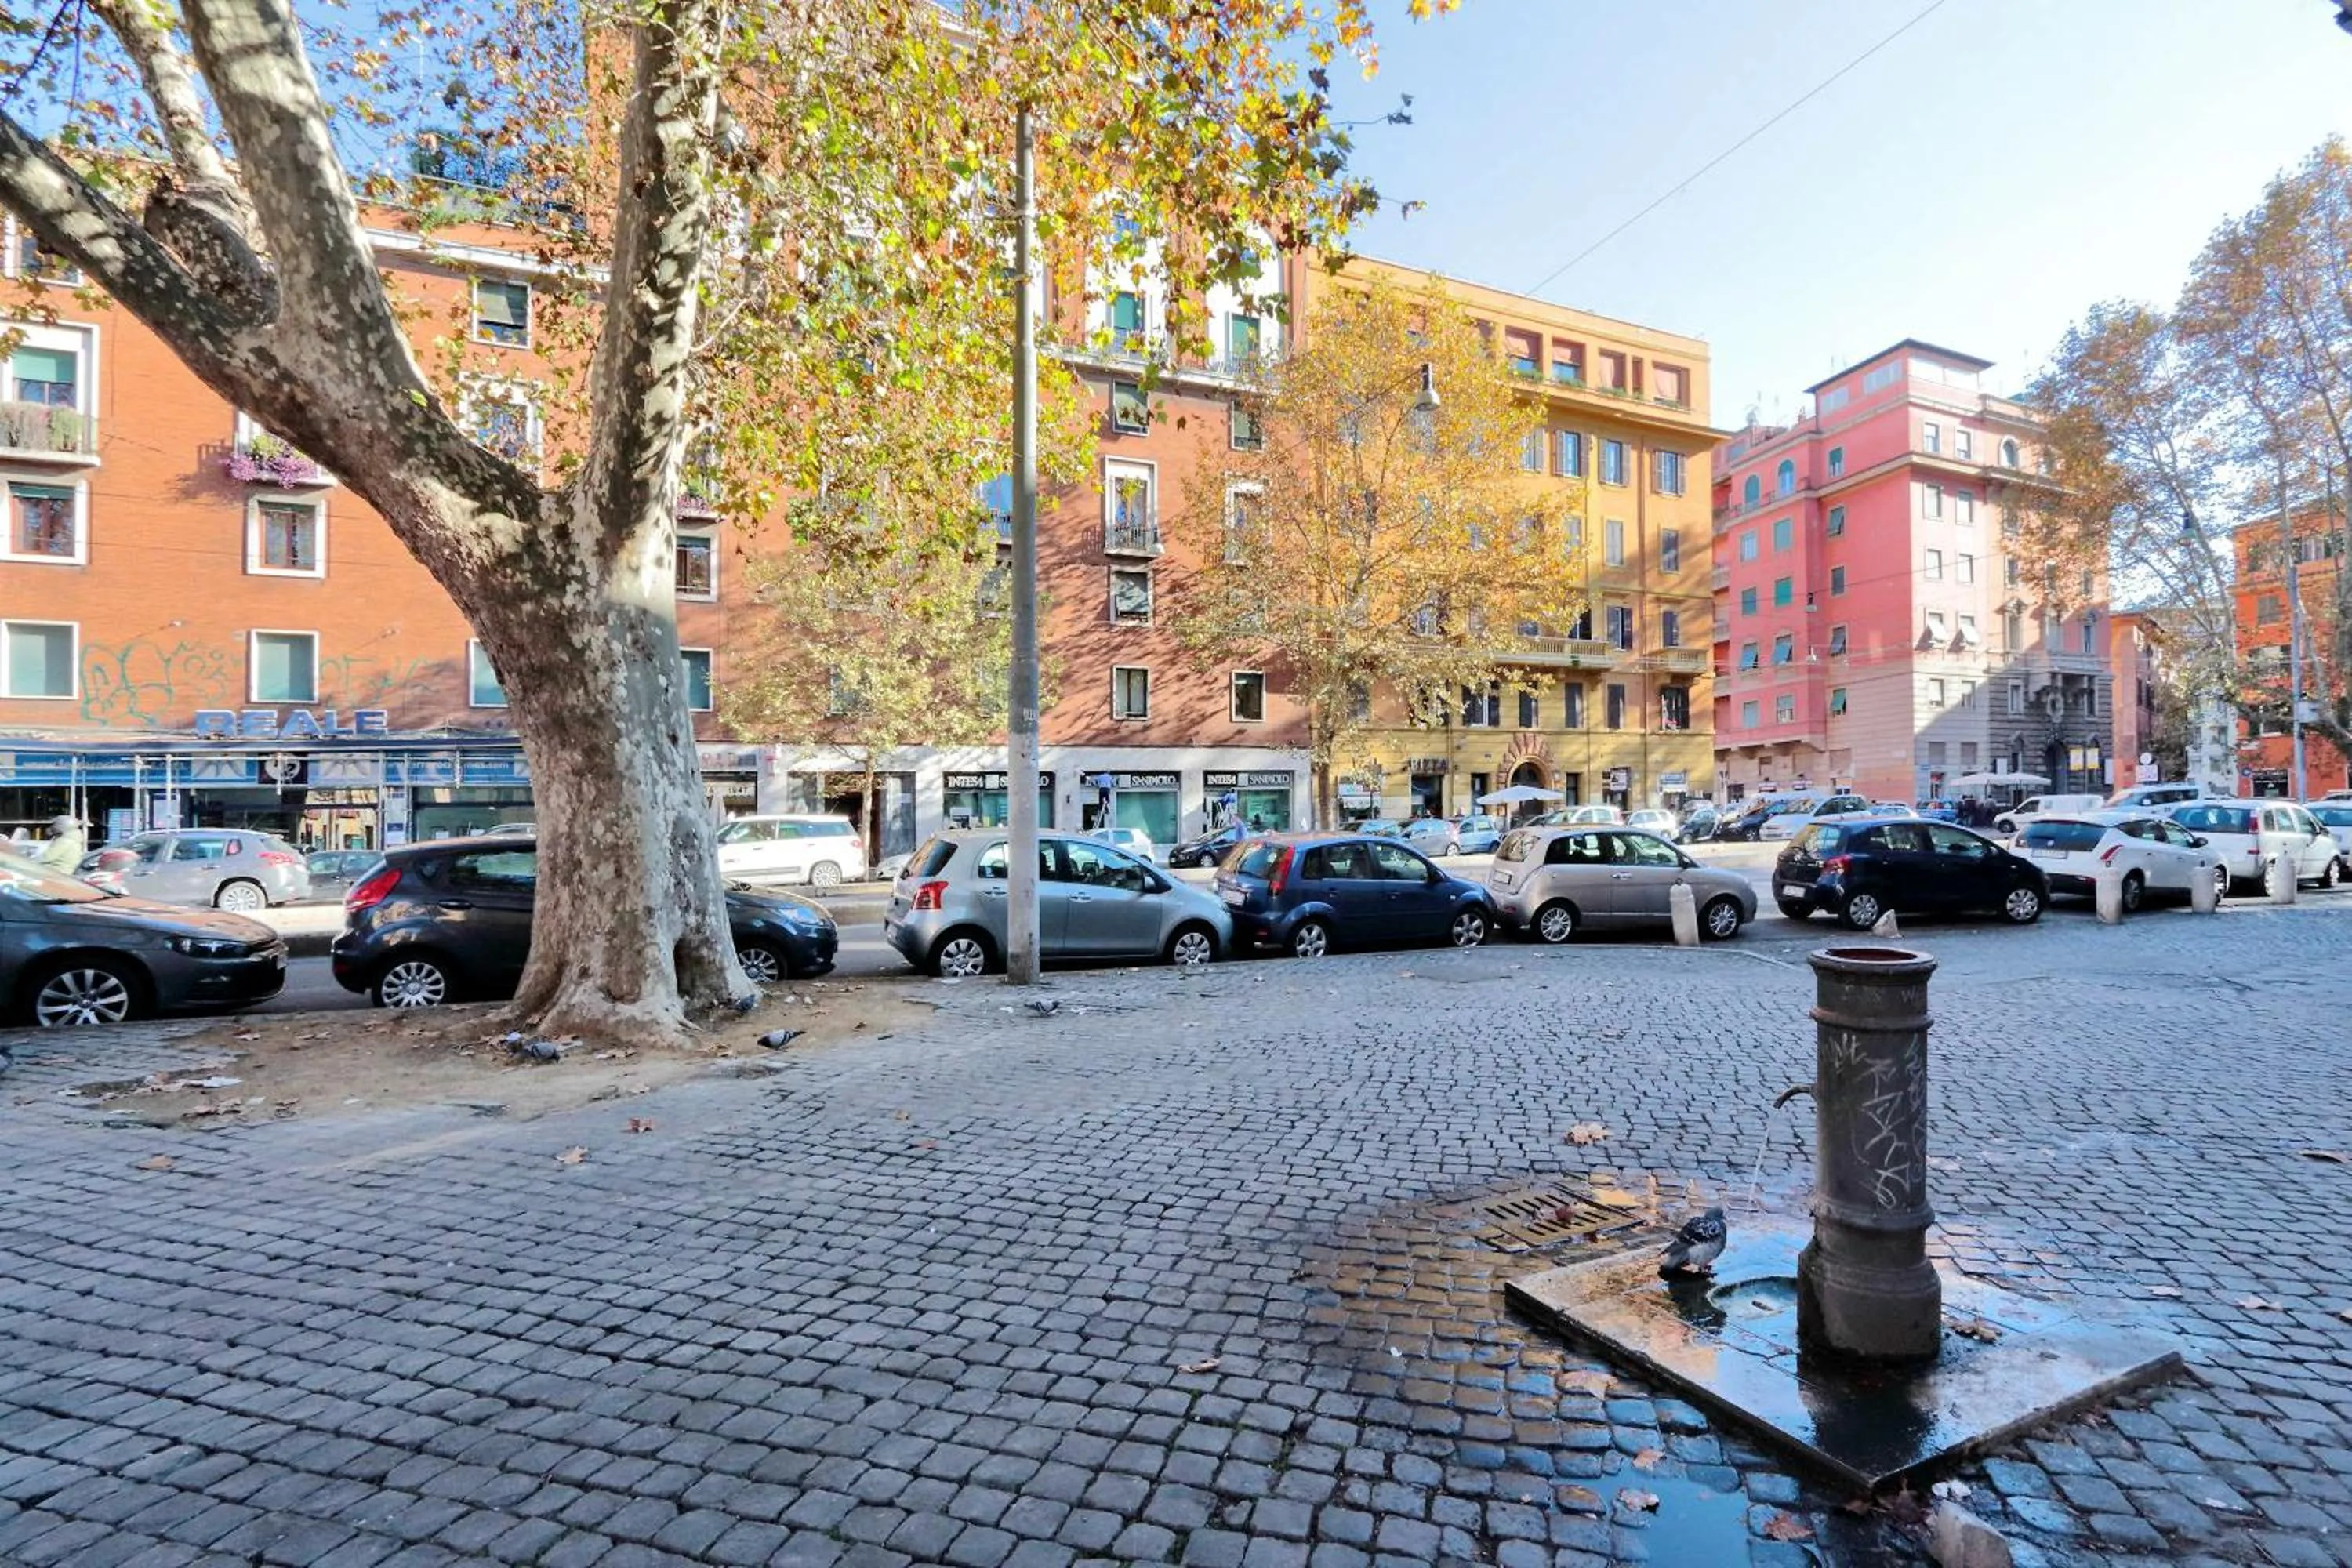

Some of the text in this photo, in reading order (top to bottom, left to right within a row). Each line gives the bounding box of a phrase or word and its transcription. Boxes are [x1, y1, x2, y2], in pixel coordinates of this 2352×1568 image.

[194, 709, 388, 739] REALE
[947, 775, 984, 788] INTESA
[1131, 775, 1177, 786] SANPAOLO
[1207, 774, 1237, 786] INTESA
